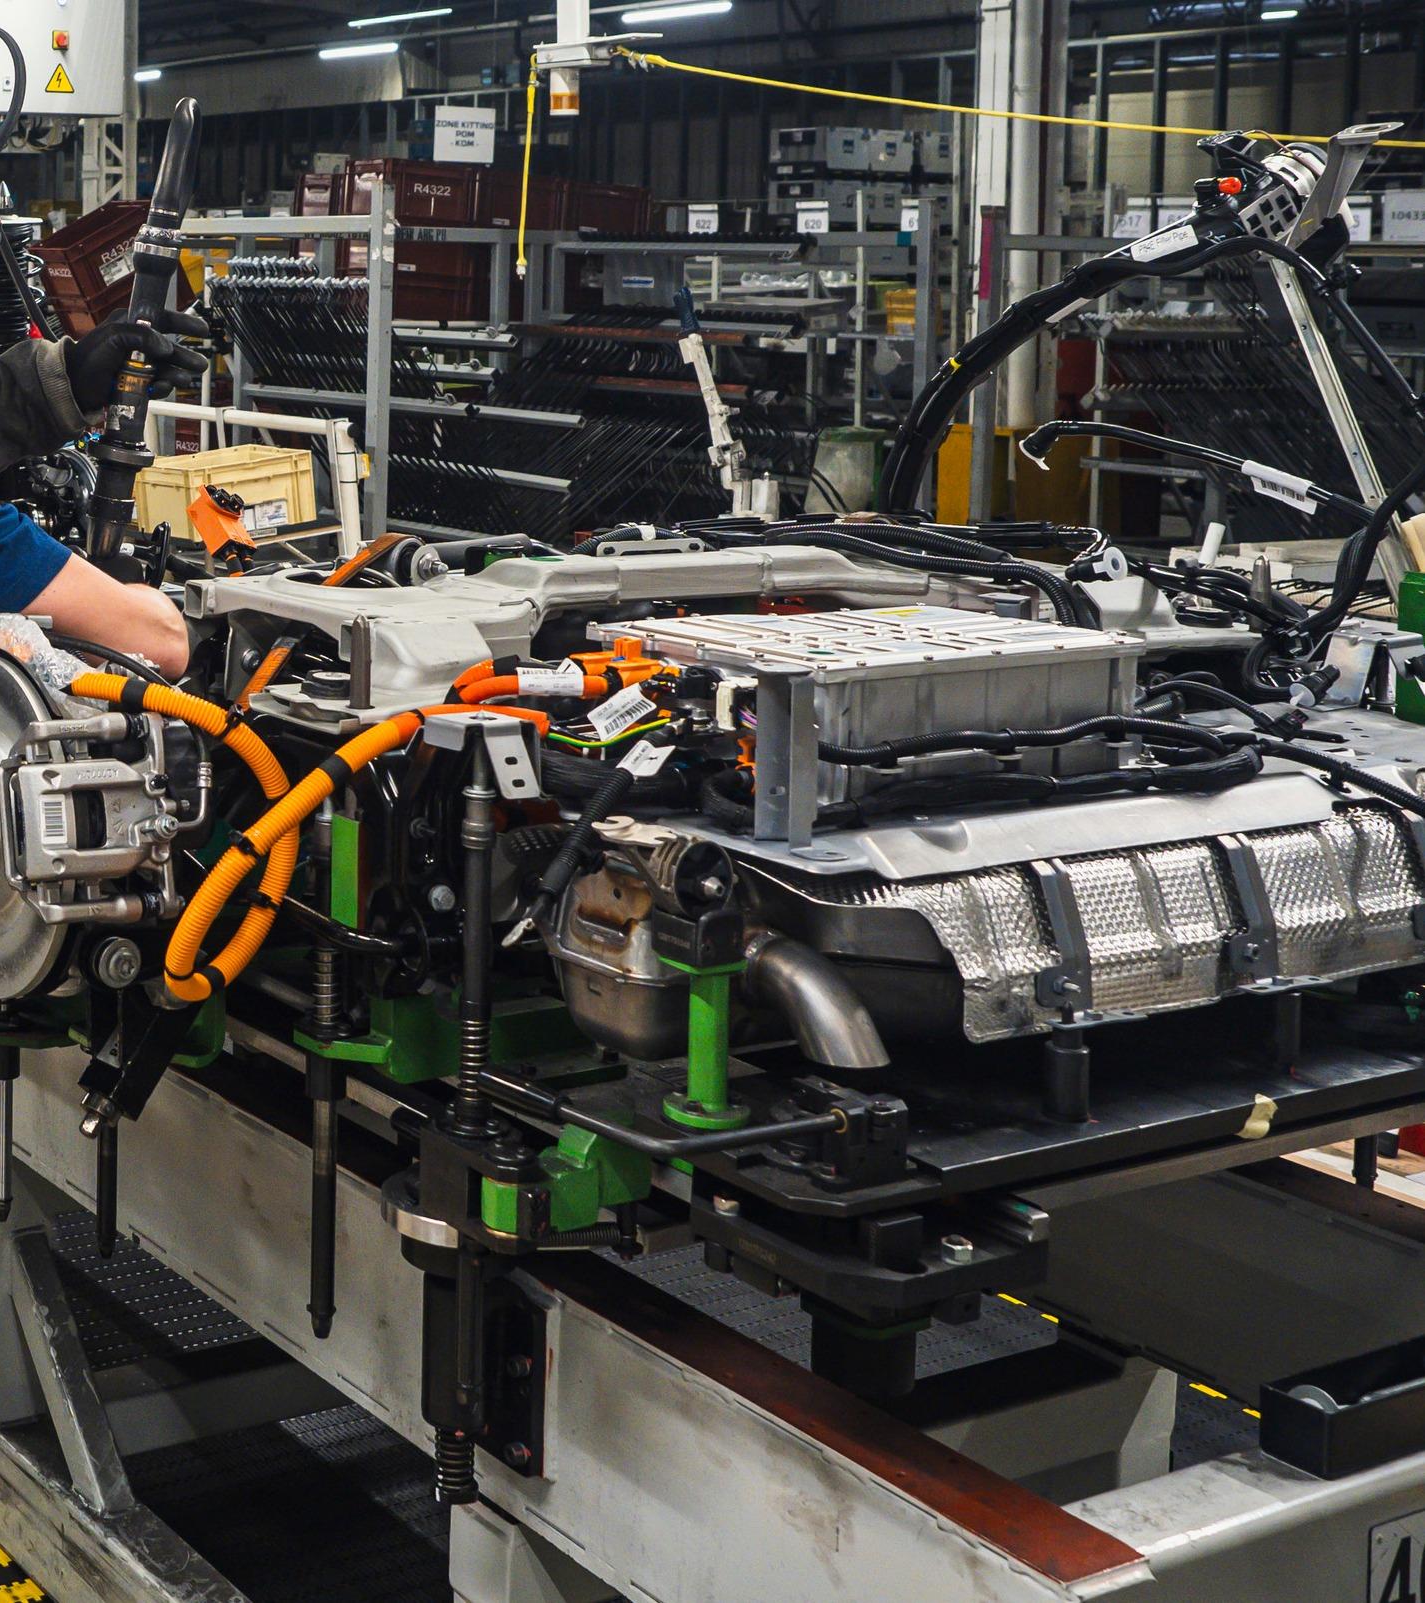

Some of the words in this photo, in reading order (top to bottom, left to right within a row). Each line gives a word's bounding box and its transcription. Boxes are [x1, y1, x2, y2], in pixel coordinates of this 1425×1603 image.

[436, 120, 459, 128] ZONE
[413, 182, 452, 197] R4322
[695, 218, 712, 230] 622
[804, 218, 823, 230] 620
[175, 440, 200, 453] R4322
[1379, 1535, 1425, 1603] 4
